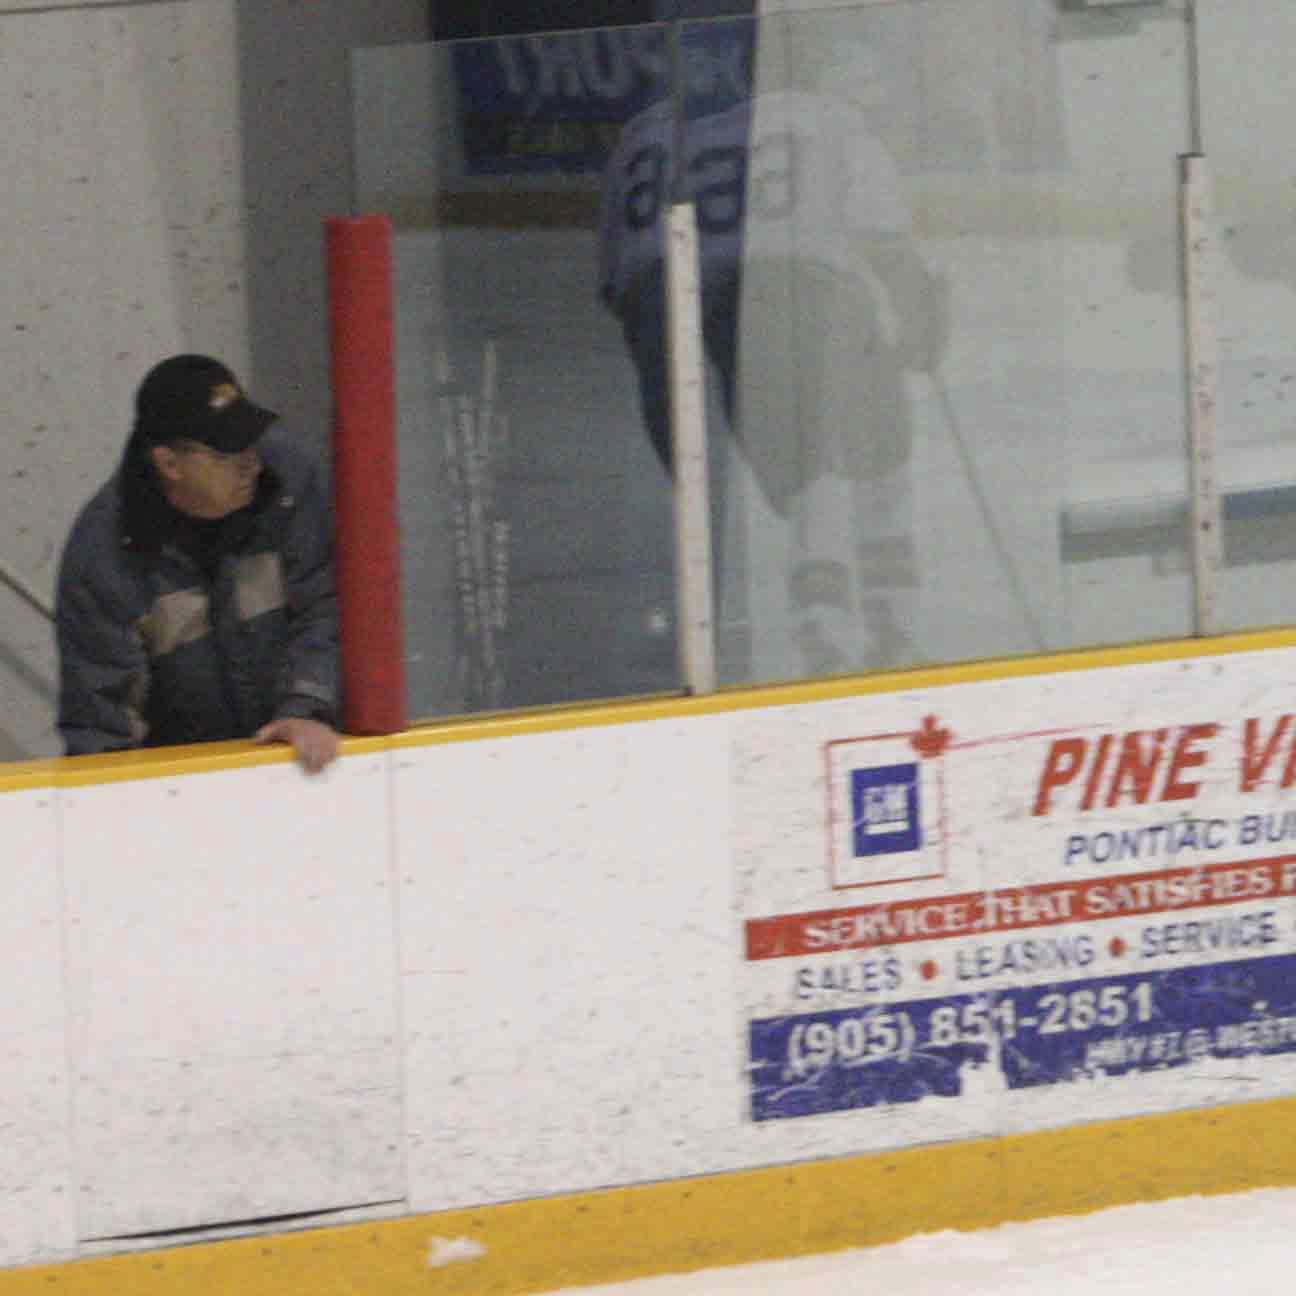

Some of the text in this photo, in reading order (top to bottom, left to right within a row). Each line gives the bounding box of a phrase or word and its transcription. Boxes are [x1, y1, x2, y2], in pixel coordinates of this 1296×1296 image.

[1030, 721, 1219, 816] PINE
[1064, 815, 1230, 866] PONTIAC
[803, 902, 969, 948] SERVICE
[975, 886, 1075, 930] THAT
[1087, 866, 1271, 915] SATISFIES
[795, 955, 903, 1000] SALES
[956, 933, 1096, 980] LEASING
[1140, 910, 1277, 960] SERVICE
[786, 1008, 915, 1079] (905)
[930, 981, 1155, 1048] 851-2851
